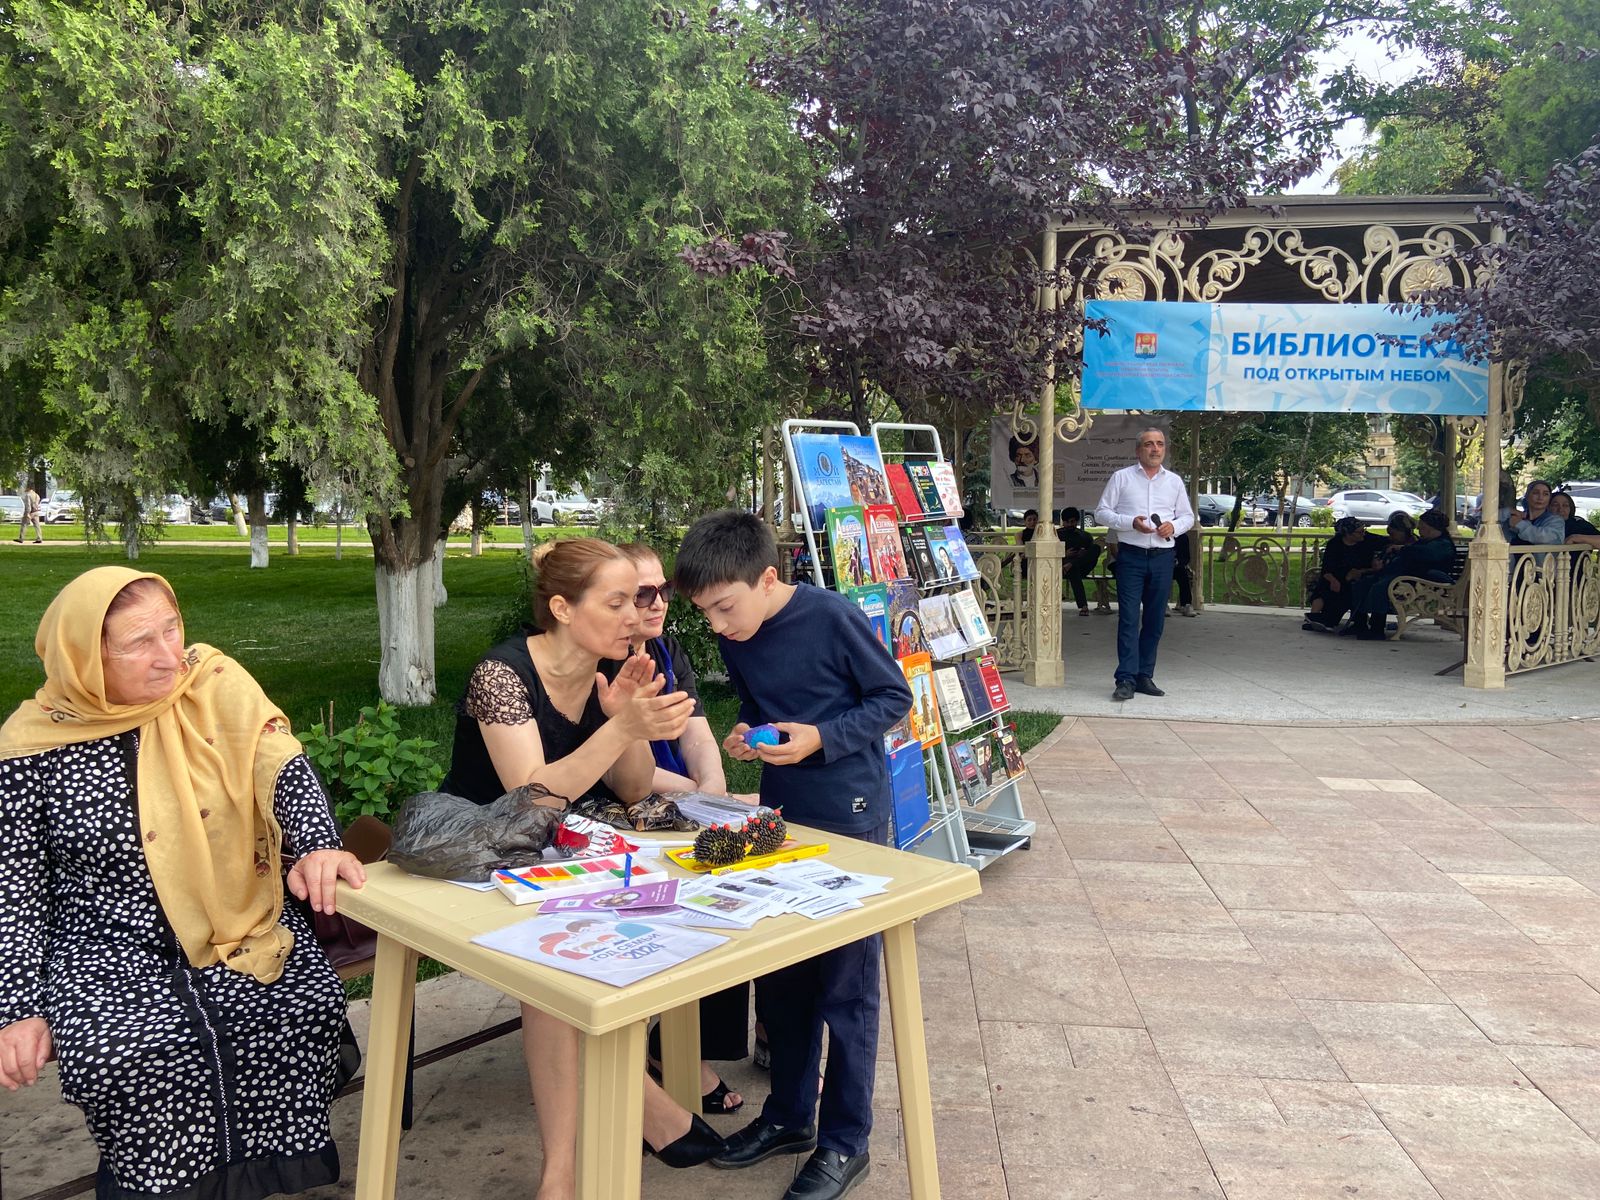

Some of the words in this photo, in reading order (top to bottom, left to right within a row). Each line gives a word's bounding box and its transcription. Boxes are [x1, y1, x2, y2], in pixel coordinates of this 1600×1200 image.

[1231, 332, 1465, 360] БИБЛИОТЕКА
[1243, 367, 1279, 382] ПОД
[1285, 367, 1384, 382] ОТКРЫТЫМ
[1390, 369, 1450, 382] НЕБОМ
[590, 950, 620, 961] ГОД
[617, 933, 660, 951] СЕМЬИ
[622, 942, 666, 960] 2024
